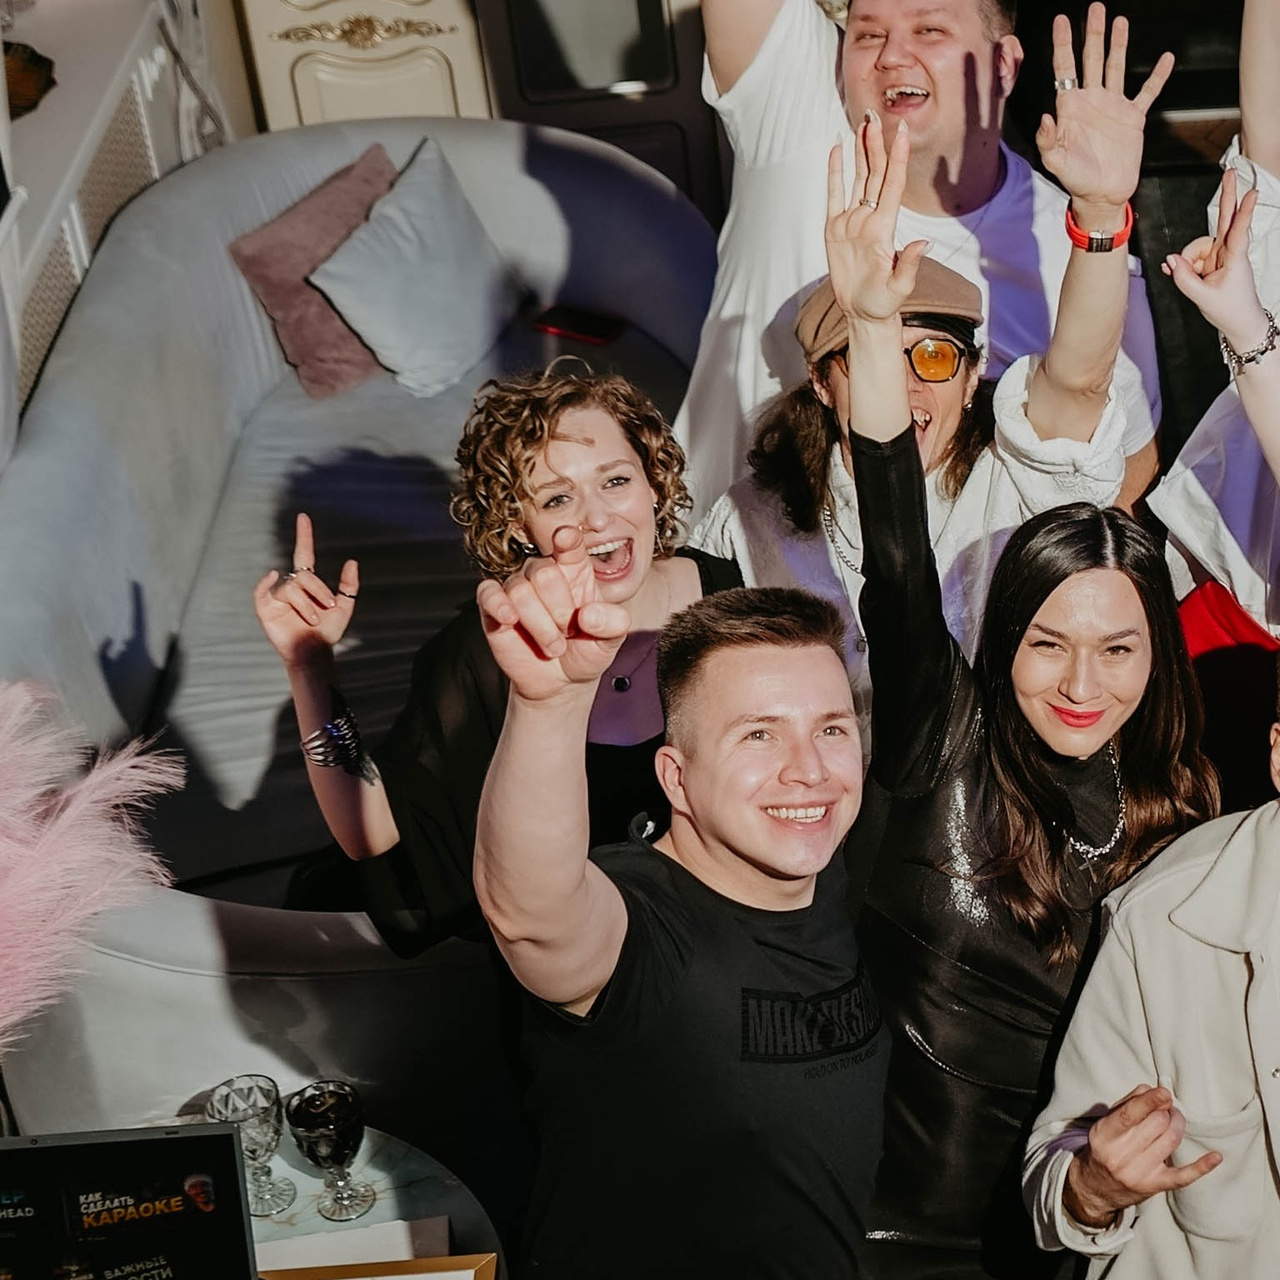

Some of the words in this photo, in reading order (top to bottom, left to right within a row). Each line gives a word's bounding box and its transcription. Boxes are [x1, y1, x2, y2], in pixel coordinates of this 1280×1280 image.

[78, 1191, 103, 1205] КАК
[80, 1195, 135, 1214] СДЕЛАТЬ
[82, 1196, 185, 1230] КАРАОКЕ
[104, 1255, 168, 1280] ВАЖНЫЕ
